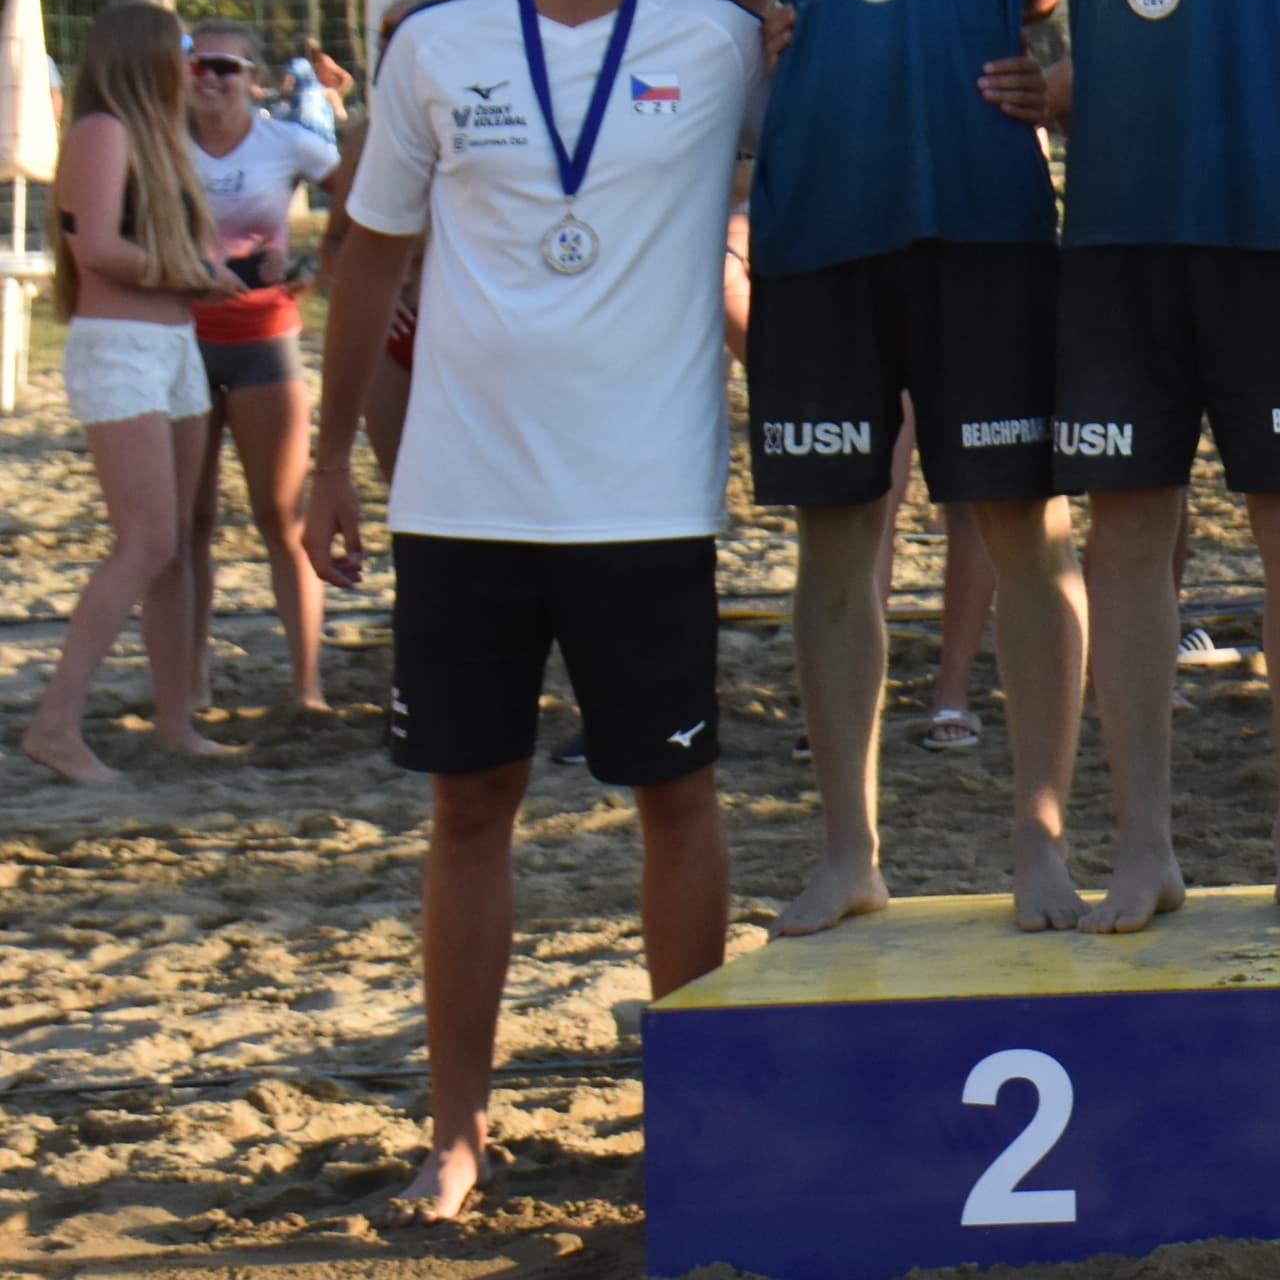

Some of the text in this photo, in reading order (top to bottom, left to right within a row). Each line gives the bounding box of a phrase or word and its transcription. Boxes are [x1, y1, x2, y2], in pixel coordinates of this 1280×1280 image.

[783, 421, 871, 455] USN
[1060, 421, 1133, 455] USN
[960, 1049, 1077, 1227] 2
